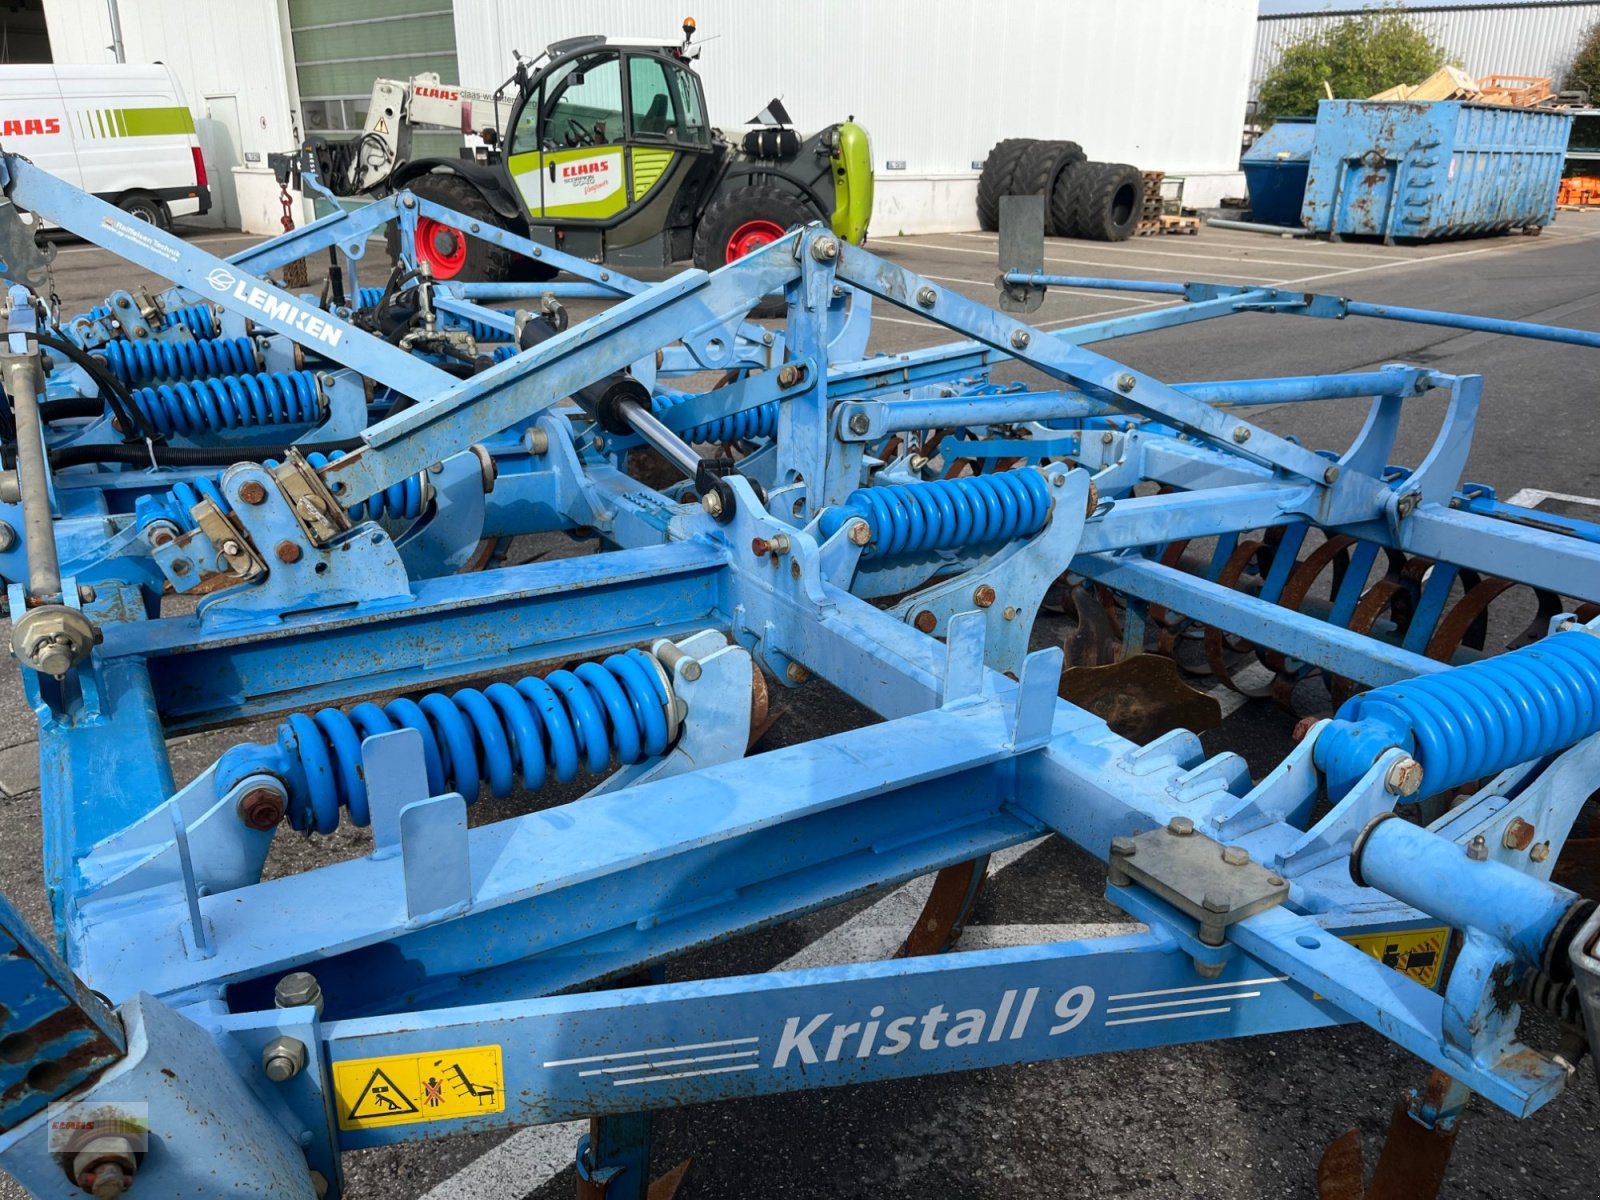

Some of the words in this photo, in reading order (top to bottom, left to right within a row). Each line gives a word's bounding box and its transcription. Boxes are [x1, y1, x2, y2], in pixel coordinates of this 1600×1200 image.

[415, 87, 459, 101] CLAAS
[0, 118, 60, 136] AAS
[563, 161, 608, 177] CLAAS
[116, 222, 153, 244] Raiffeisen
[153, 239, 181, 257] Technik
[233, 279, 344, 348] LEMKEN
[772, 987, 1040, 1069] Kristall
[1049, 985, 1096, 1036] 9
